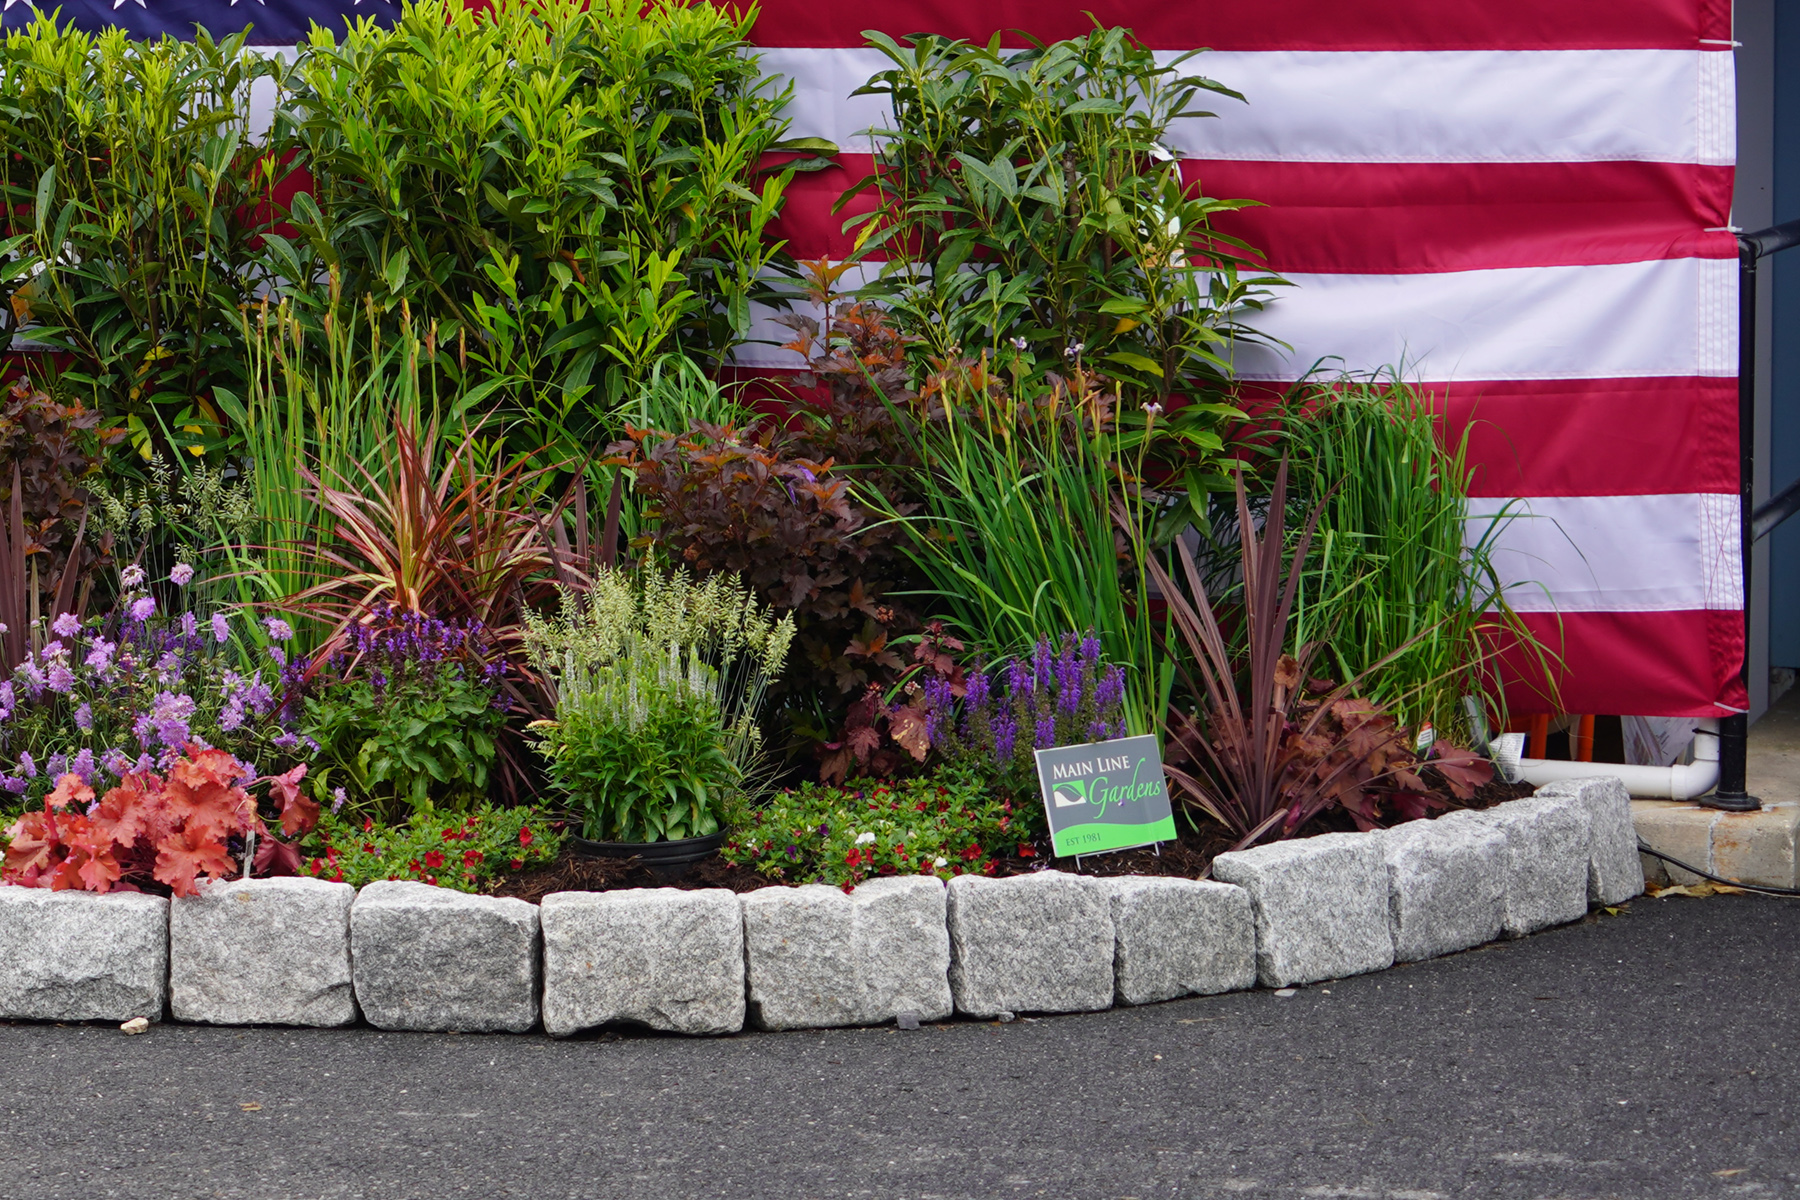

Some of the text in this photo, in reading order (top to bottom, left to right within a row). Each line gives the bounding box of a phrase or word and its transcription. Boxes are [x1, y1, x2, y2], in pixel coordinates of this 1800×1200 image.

[1052, 755, 1131, 780] MAIN LINE
[1089, 757, 1162, 819] Gardens
[1065, 832, 1102, 847] EST 1981
